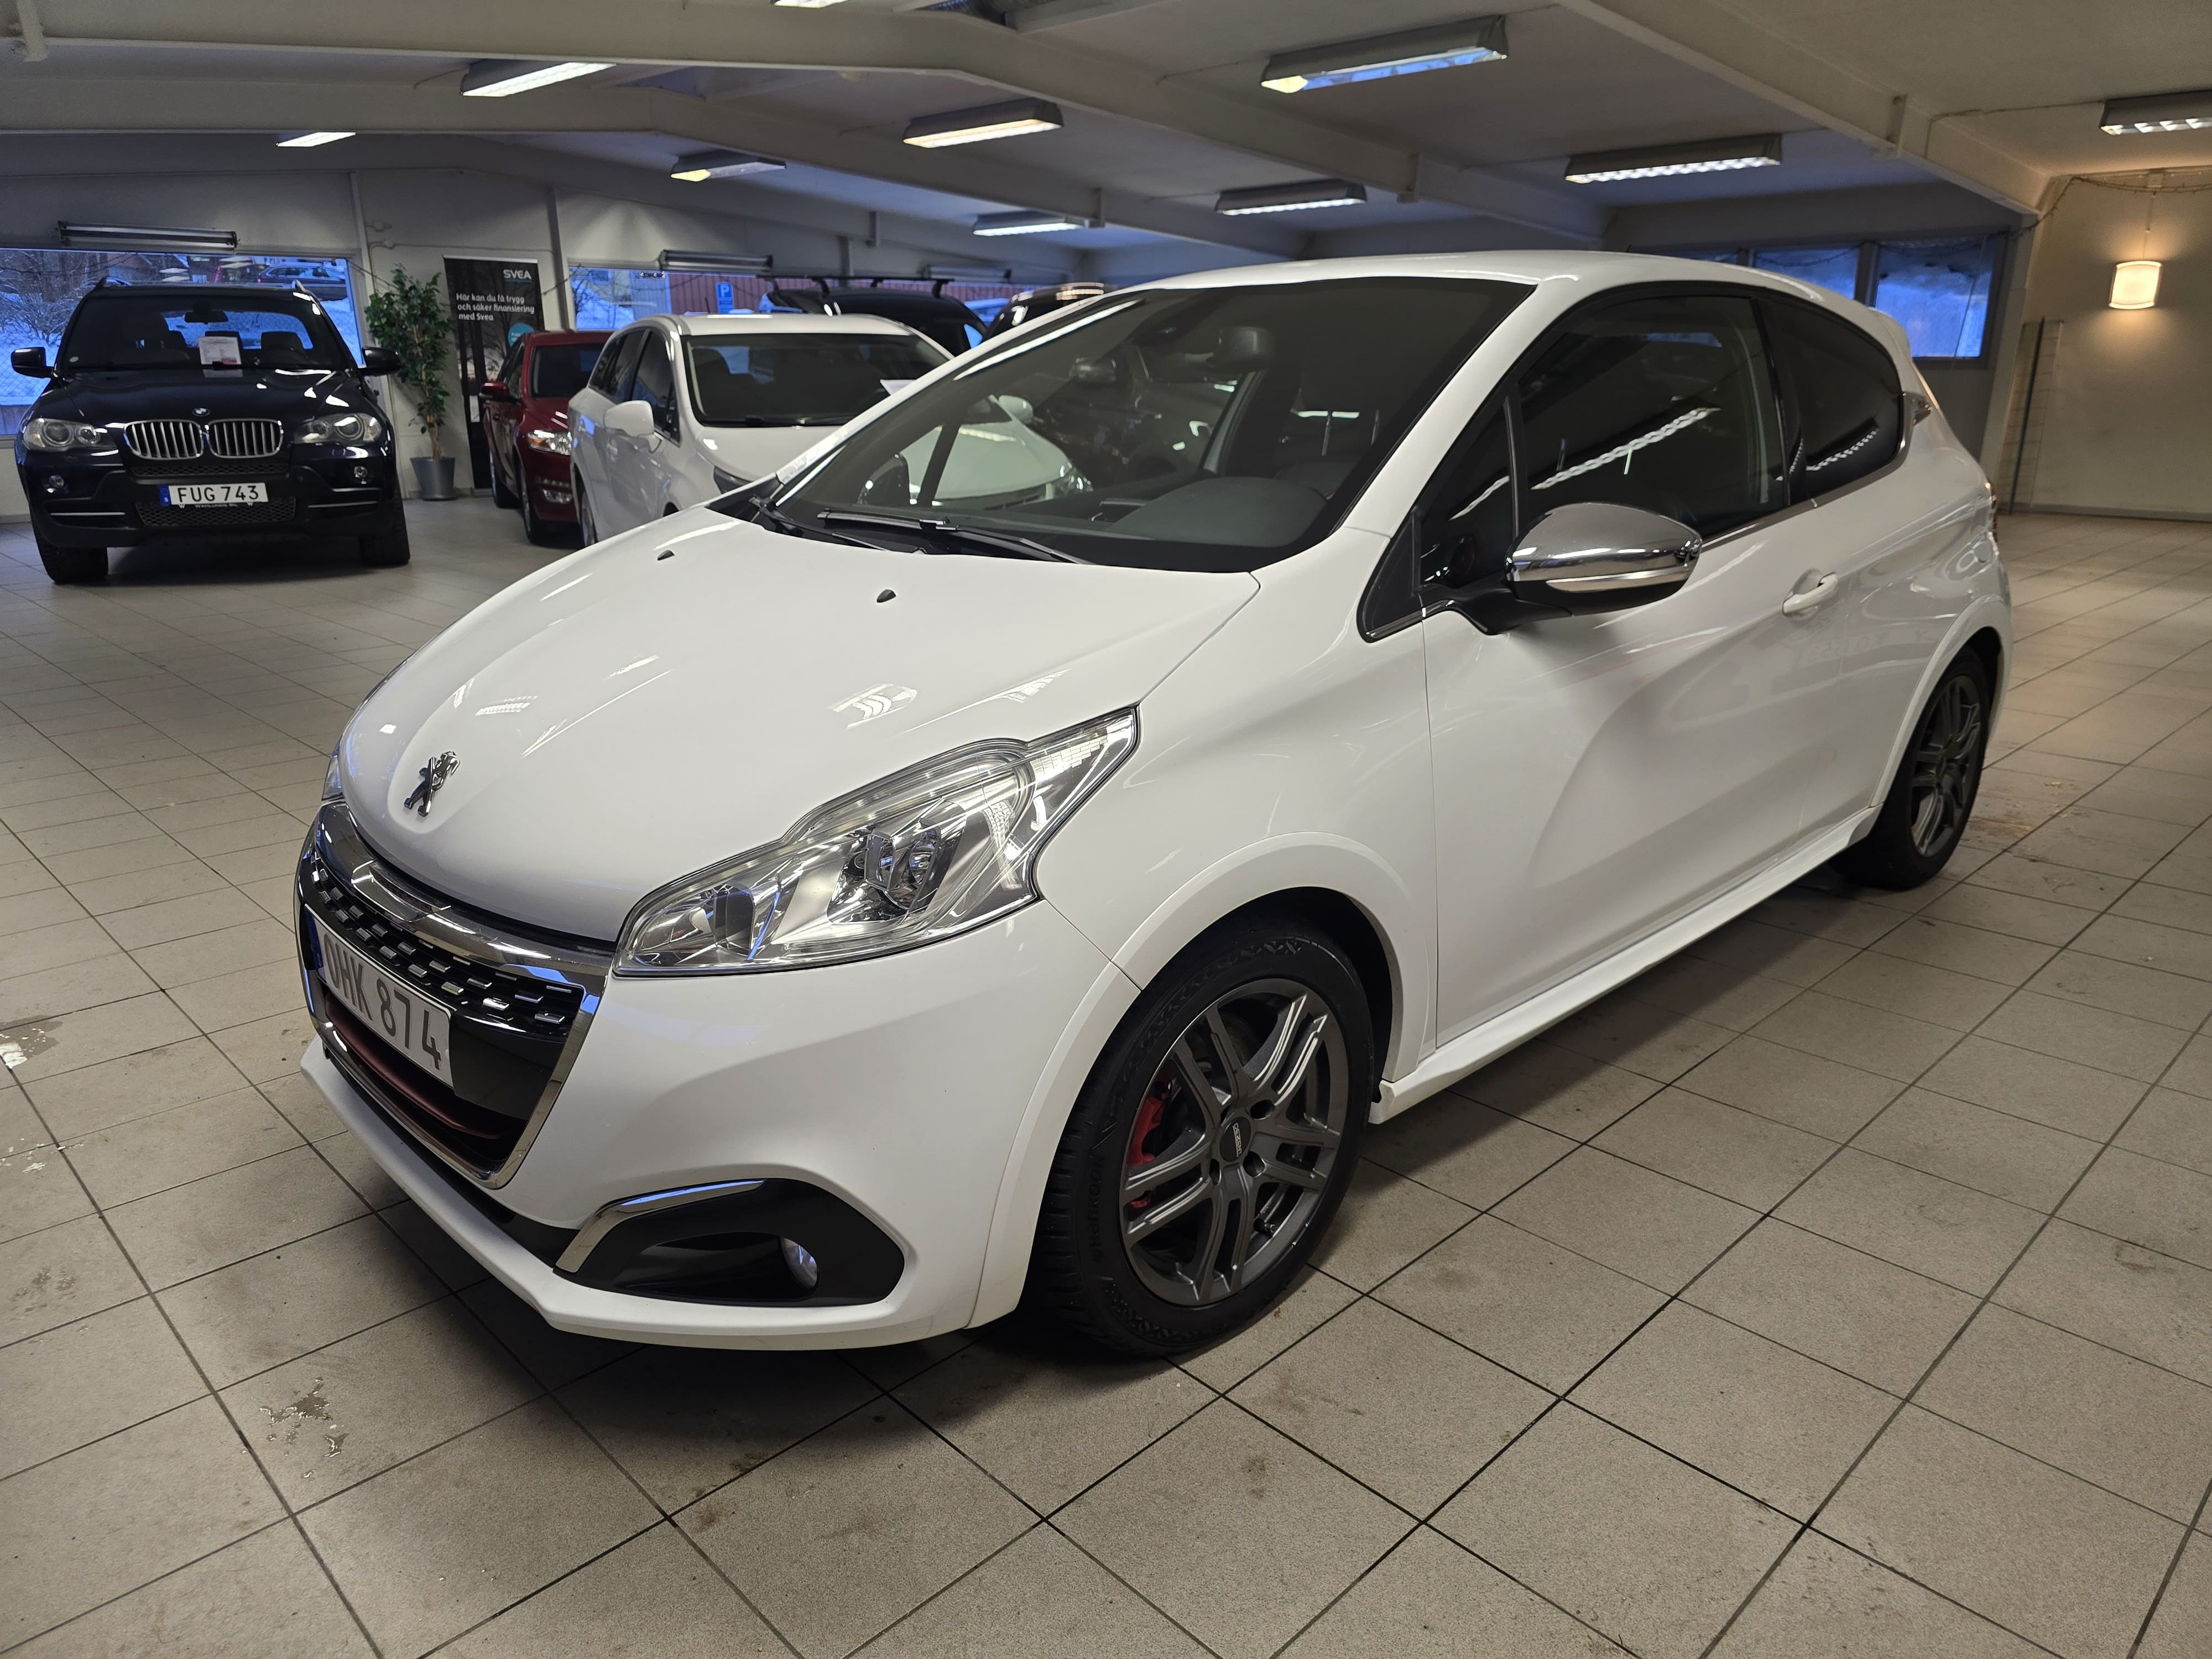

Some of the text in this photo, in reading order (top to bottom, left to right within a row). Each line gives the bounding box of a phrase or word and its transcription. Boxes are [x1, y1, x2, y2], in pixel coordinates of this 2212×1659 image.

[503, 269, 531, 280] SVEA
[721, 285, 729, 298] P
[456, 293, 524, 304] Här kan du få trygg
[494, 304, 534, 314] finansiering
[476, 312, 494, 321] Svea
[178, 485, 259, 503] FUG 743
[324, 933, 442, 1071] OHK 874
